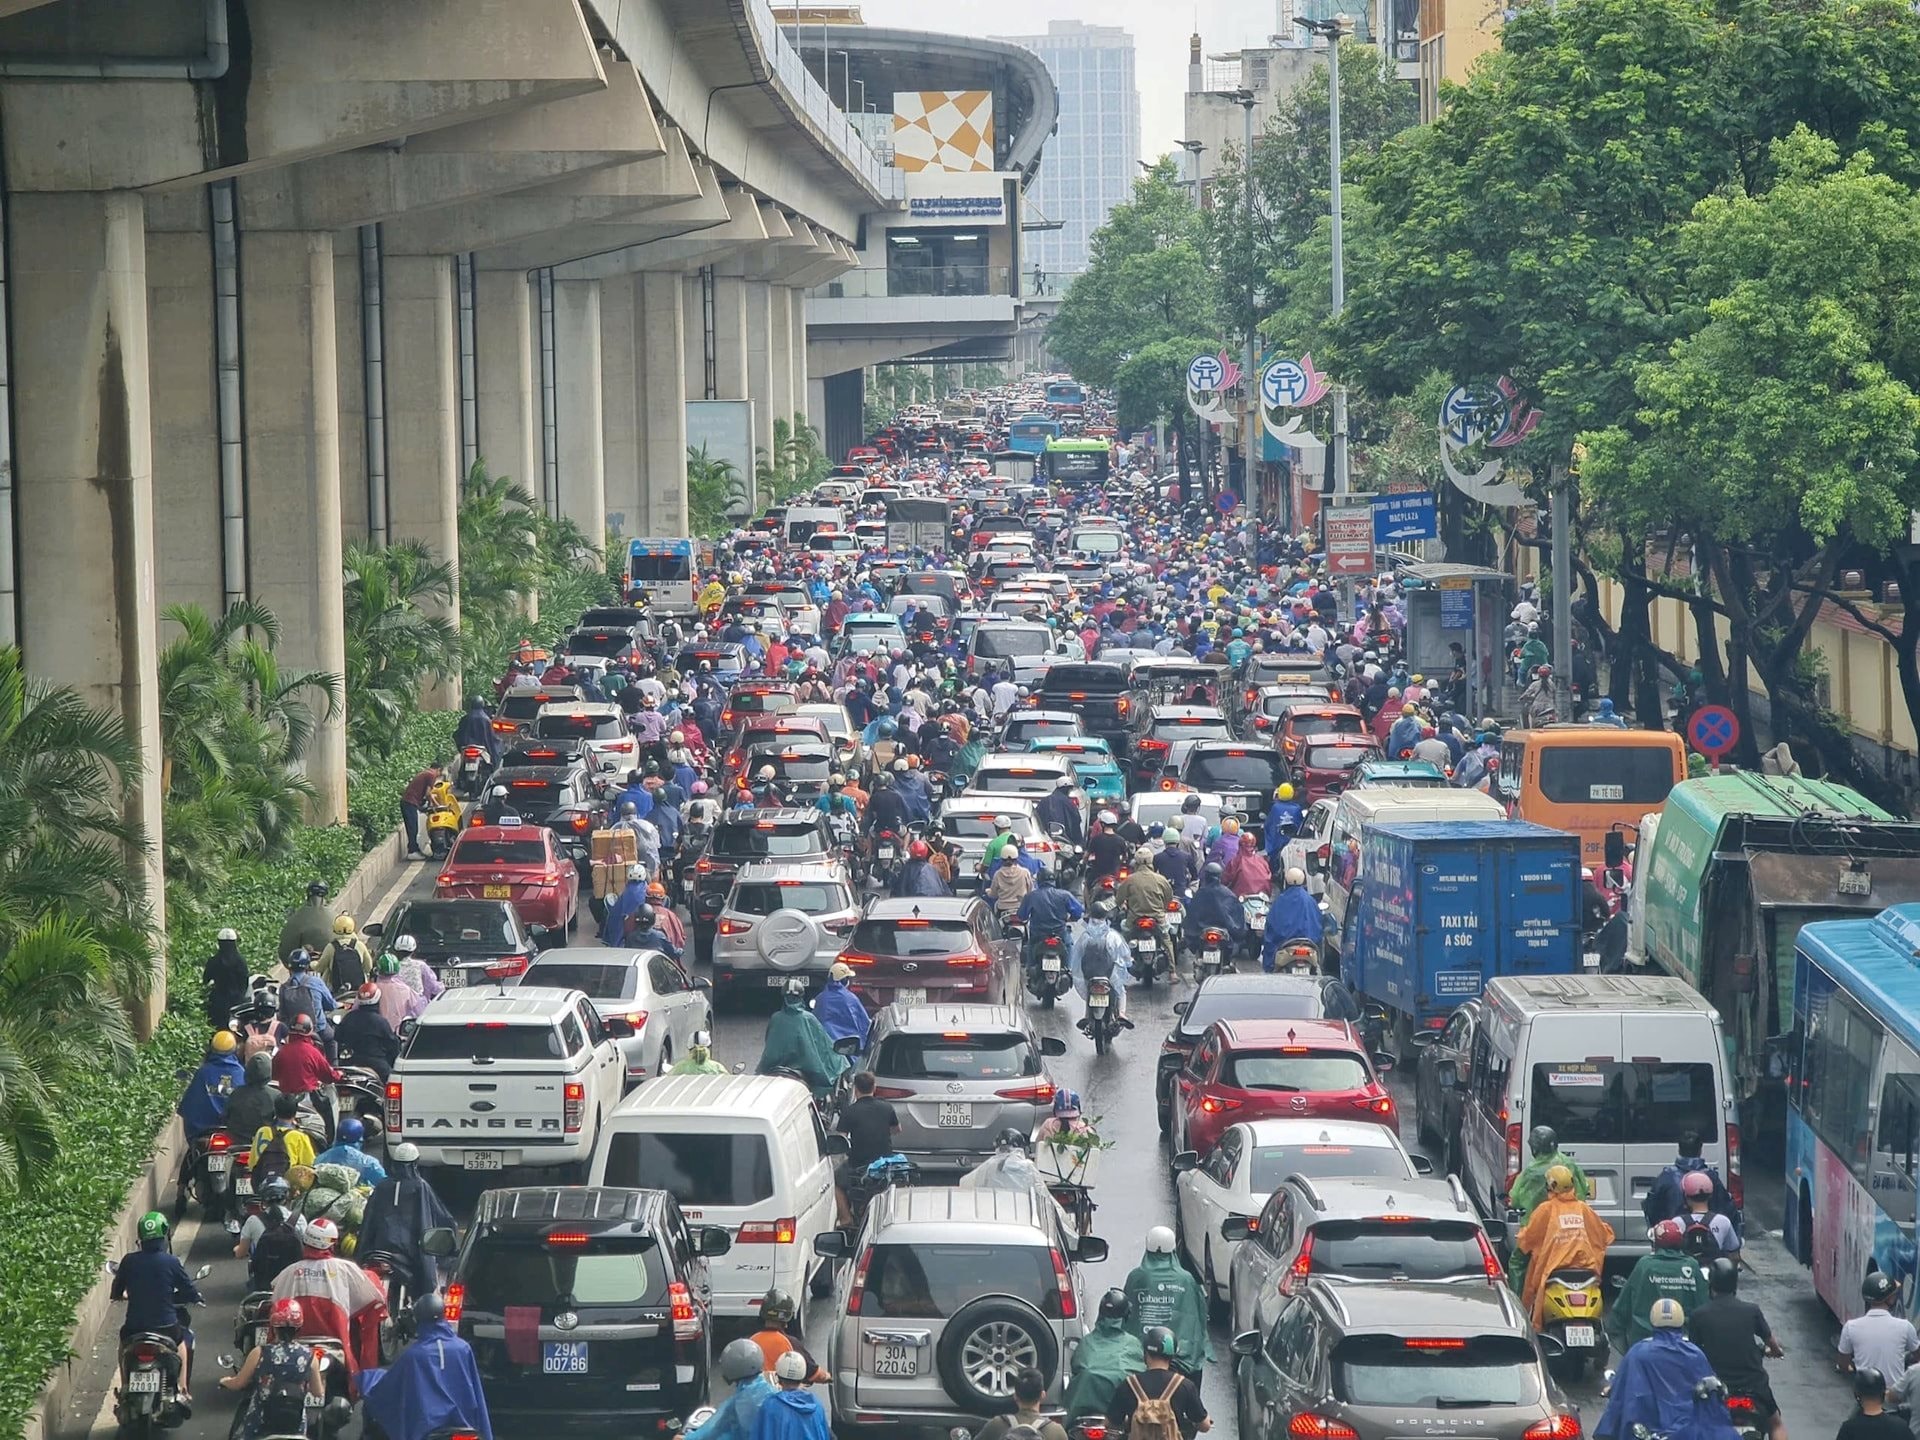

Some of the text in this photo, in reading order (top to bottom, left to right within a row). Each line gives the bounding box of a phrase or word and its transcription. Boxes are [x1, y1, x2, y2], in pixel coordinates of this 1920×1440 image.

[1440, 911, 1478, 928] TAXI TẢI
[1445, 932, 1473, 946] A SÓC
[947, 1103, 965, 1115] 30E
[406, 1118, 560, 1128] RANGER
[940, 1114, 971, 1126] 289.05
[474, 1152, 492, 1160] 29H
[1649, 1275, 1696, 1286] Vietcombank
[554, 1342, 578, 1357] 29A
[885, 1345, 908, 1360] 30A
[545, 1357, 586, 1372] 007.86
[876, 1360, 916, 1374] 220.49
